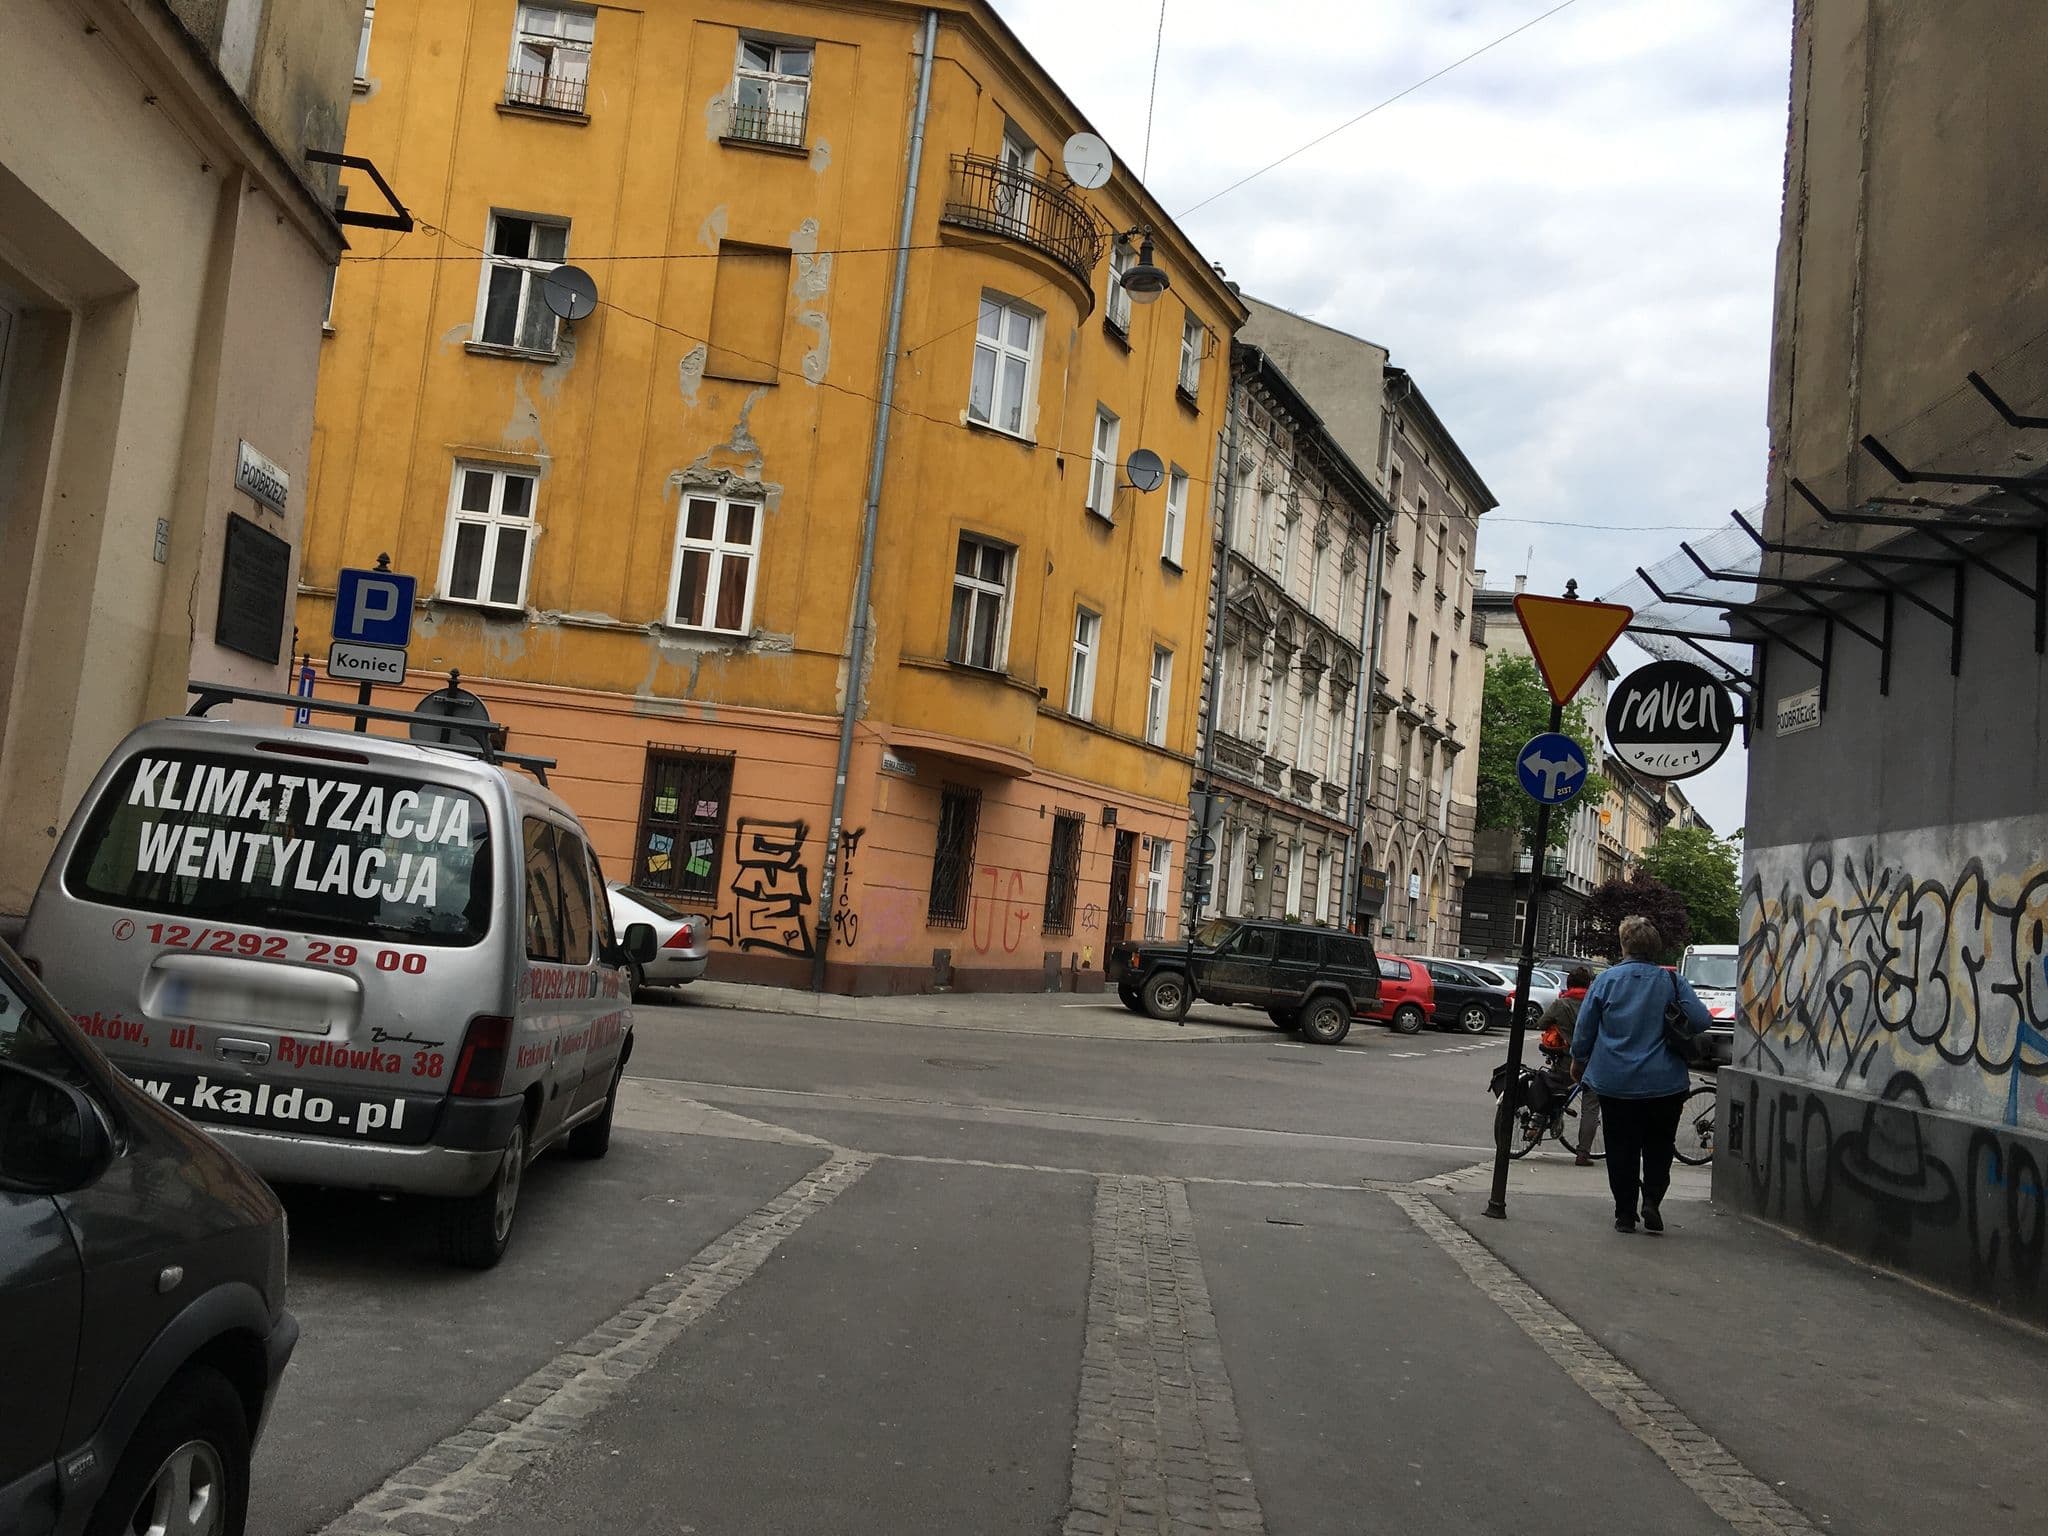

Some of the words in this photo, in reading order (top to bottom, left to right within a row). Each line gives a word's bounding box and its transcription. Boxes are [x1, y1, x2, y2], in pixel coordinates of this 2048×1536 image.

[240, 461, 288, 508] PODBRZEZIE
[352, 578, 399, 634] P
[336, 652, 398, 674] Koniec
[1619, 680, 1719, 733] raven
[1634, 749, 1700, 768] gallery
[128, 758, 470, 848] KLIMATYZACJA
[136, 821, 438, 908] WENTYLACJA
[146, 923, 287, 959] 12/292
[307, 942, 358, 967] 29
[376, 950, 427, 974] 00
[169, 1025, 203, 1051] ul.
[277, 1035, 401, 1074] Rydlówka
[411, 1052, 444, 1079] 38
